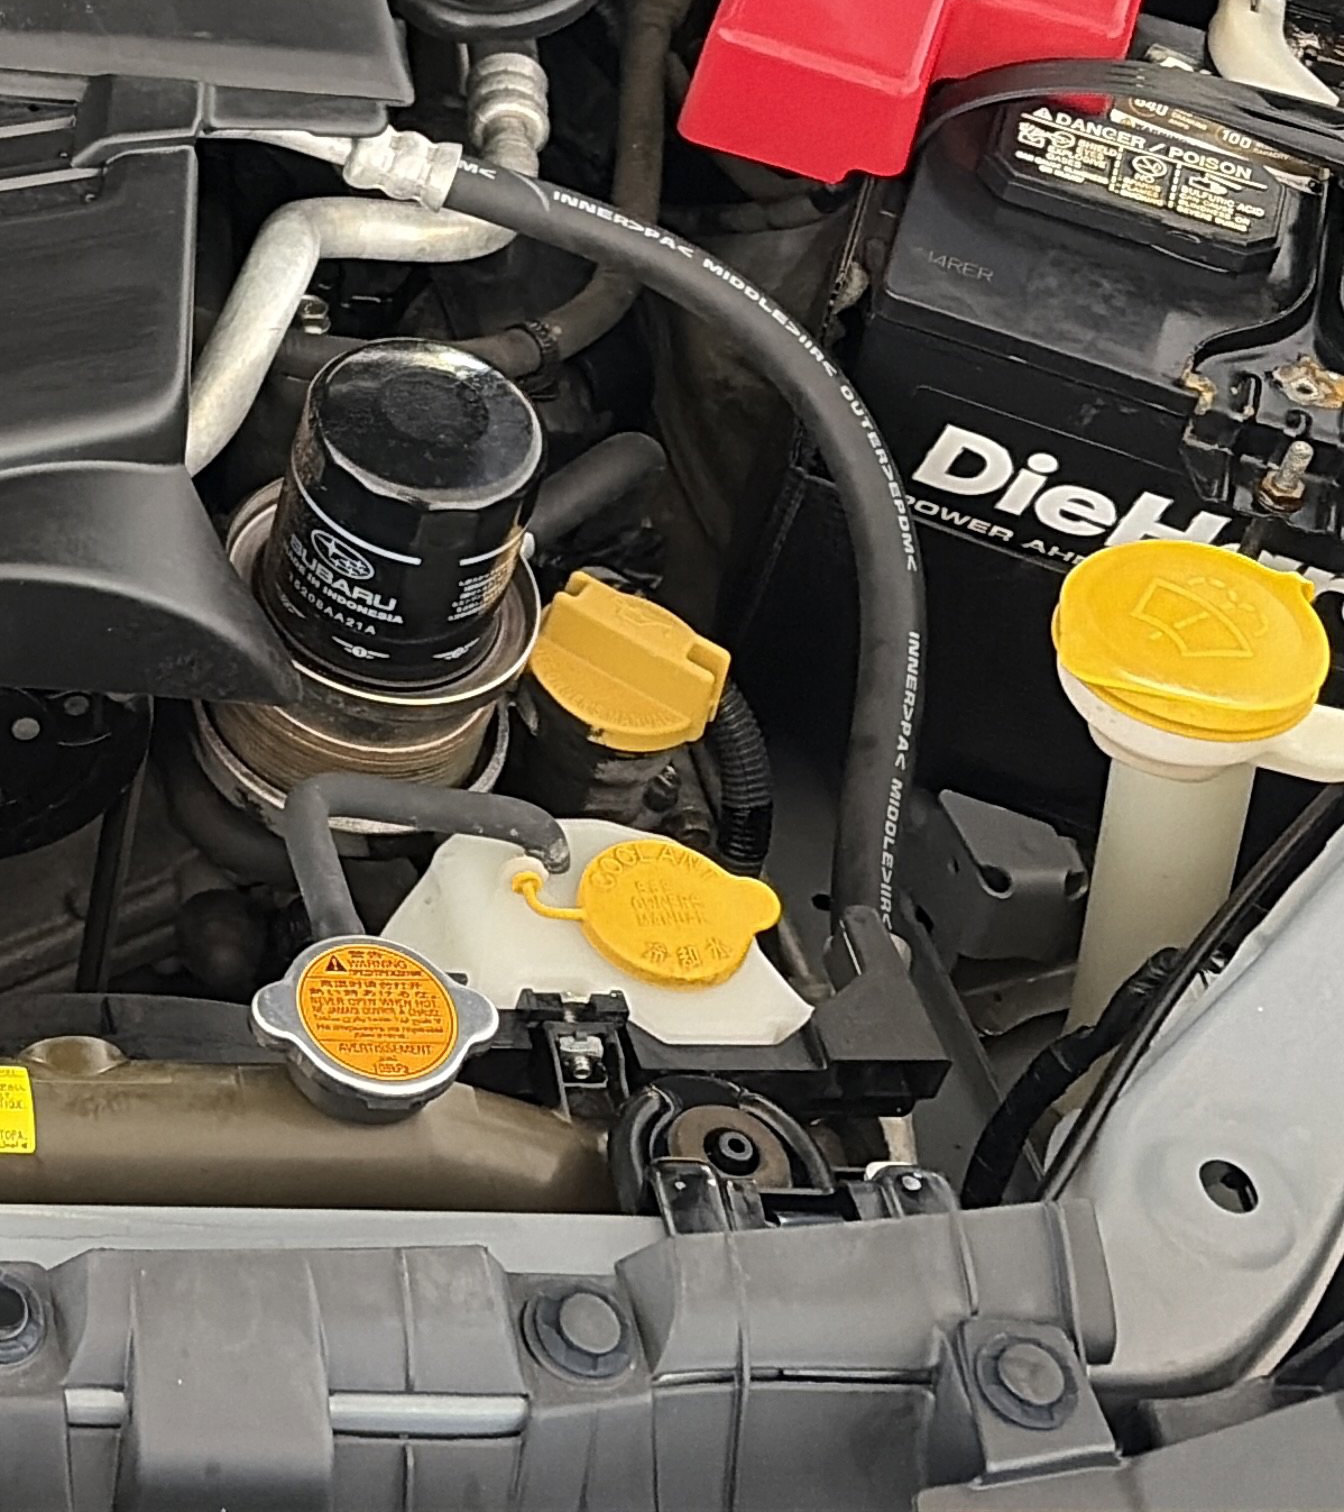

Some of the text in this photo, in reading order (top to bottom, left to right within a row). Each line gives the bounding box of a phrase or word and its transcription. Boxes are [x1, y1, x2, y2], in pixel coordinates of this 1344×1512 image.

[1055, 111, 1147, 150] DANGER
[1168, 145, 1253, 180] POISON
[1221, 128, 1252, 150] 100
[1134, 172, 1155, 184] NO
[1235, 201, 1265, 218] ACID
[291, 533, 398, 612] SUBARU
[322, 585, 404, 625] INDONESIA
[587, 843, 721, 890] COOLANT
[347, 958, 408, 970] WARNING
[338, 1042, 432, 1056] AVERTISSEMENT
